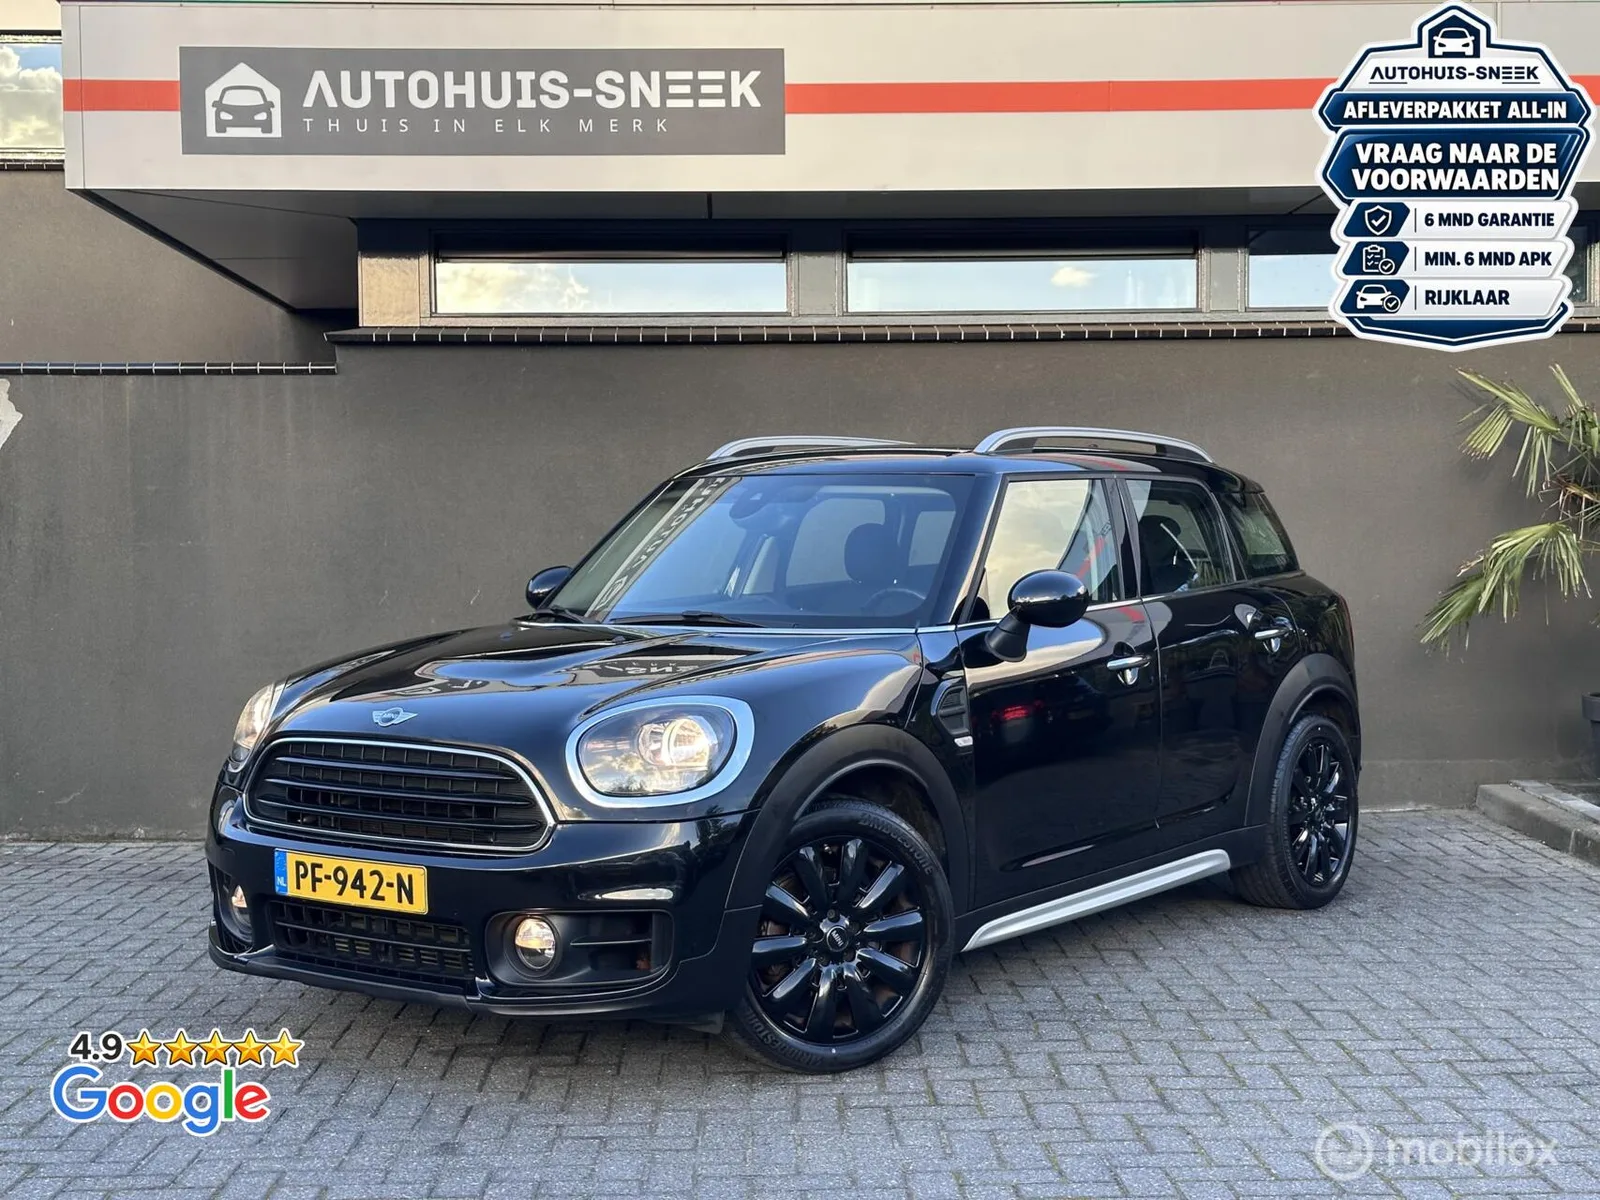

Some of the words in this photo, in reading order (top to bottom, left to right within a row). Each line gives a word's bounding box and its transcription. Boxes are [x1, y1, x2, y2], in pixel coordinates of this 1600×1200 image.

[302, 69, 763, 110] AUTOHUIS-SNEEK
[303, 118, 411, 133] THUIS
[433, 118, 466, 133] IN
[494, 119, 552, 133] ELK
[579, 119, 669, 134] MERK
[276, 876, 287, 887] NL
[295, 860, 414, 905] PF-942-N
